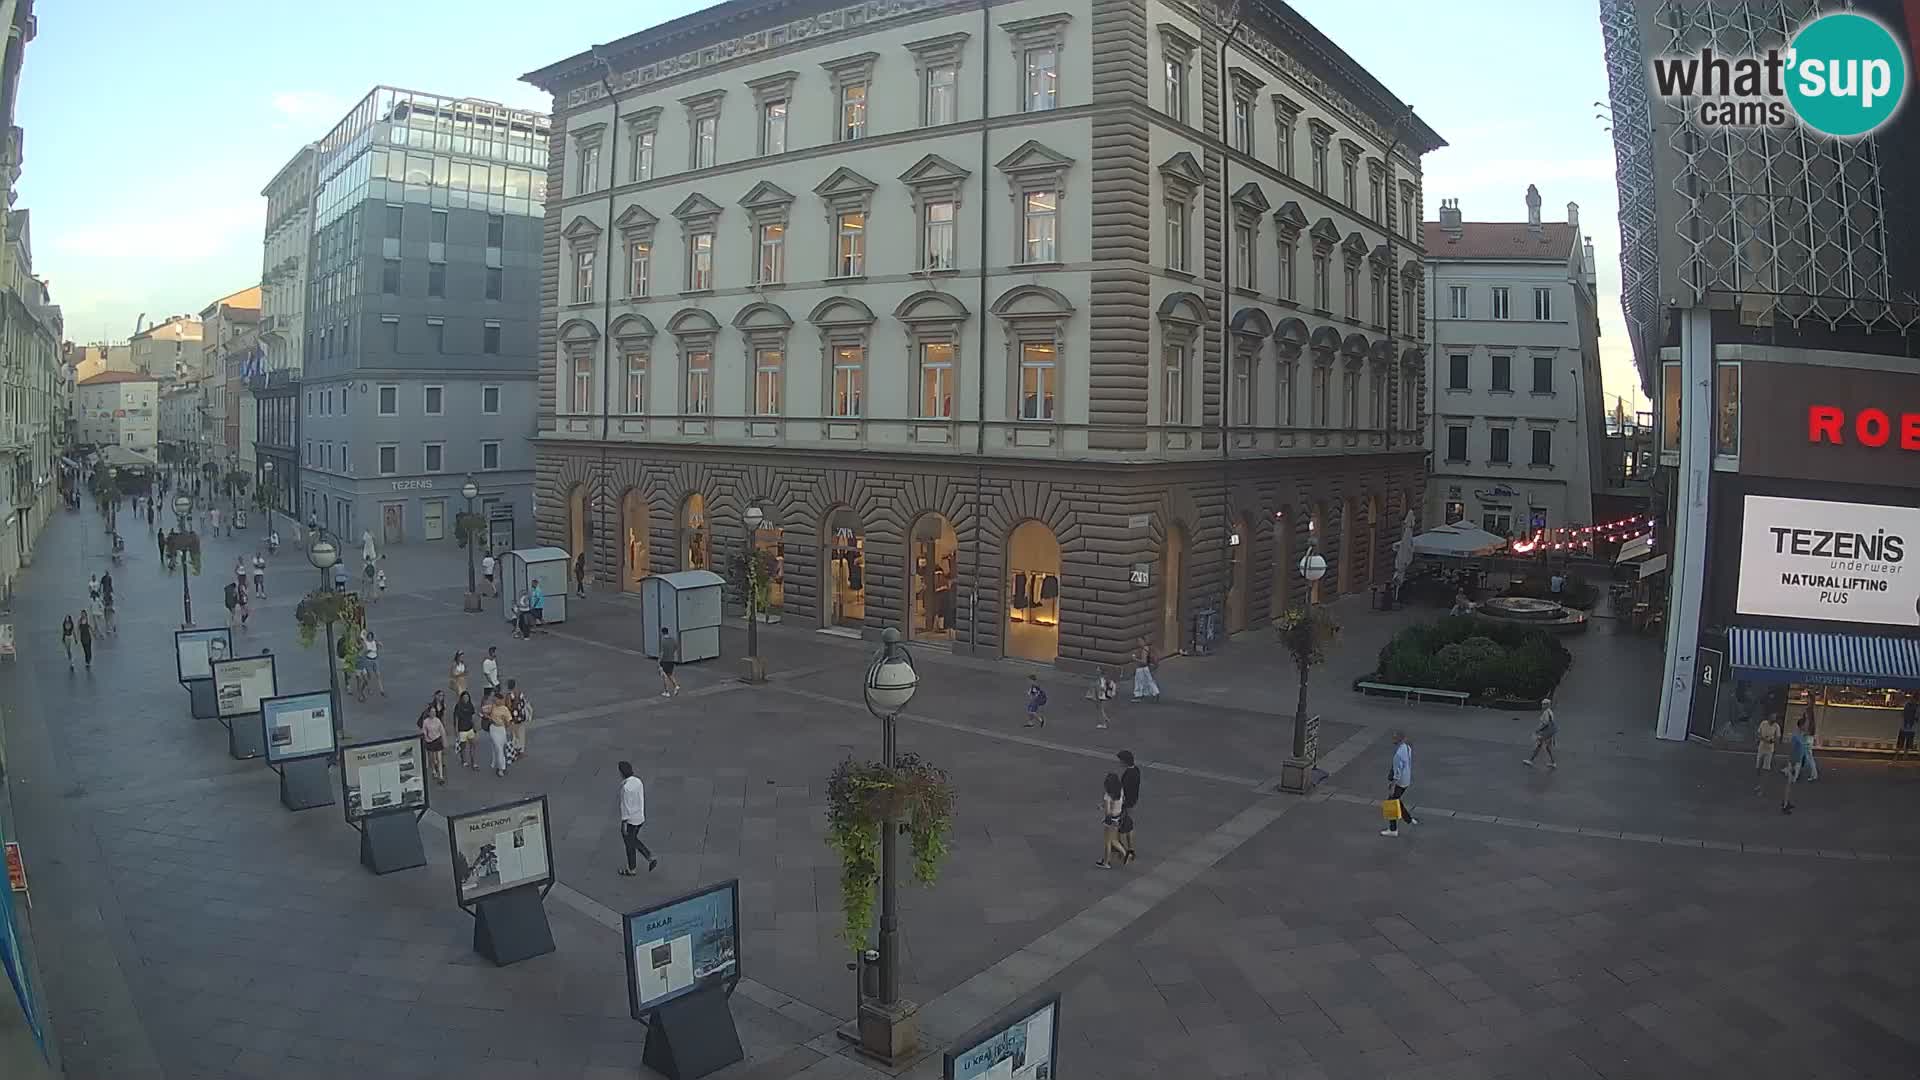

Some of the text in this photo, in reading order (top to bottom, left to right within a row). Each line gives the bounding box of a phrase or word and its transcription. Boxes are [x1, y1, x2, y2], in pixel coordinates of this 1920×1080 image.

[391, 479, 433, 491] TEZENIS
[1829, 559, 1903, 574] underwear
[1781, 572, 1888, 592] NATURAL LIFTING
[1819, 591, 1849, 604] PLUS
[469, 824, 480, 832] NA
